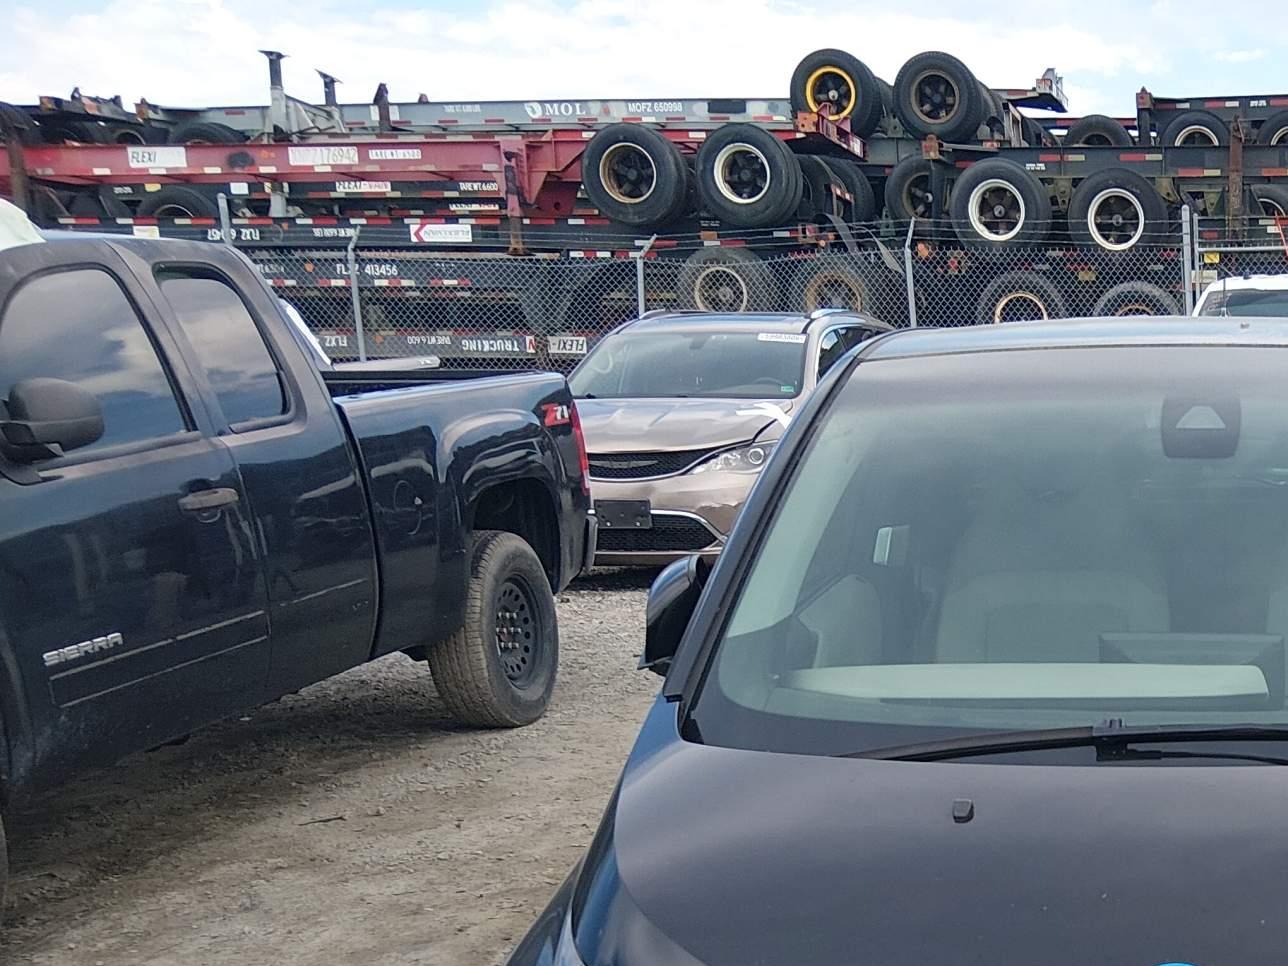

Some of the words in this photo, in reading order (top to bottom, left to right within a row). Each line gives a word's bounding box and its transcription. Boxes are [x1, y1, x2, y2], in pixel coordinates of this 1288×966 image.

[545, 103, 585, 116] MOL
[461, 339, 520, 351] TRUCKING
[541, 402, 570, 427] Z71
[42, 632, 124, 667] SIERRA
